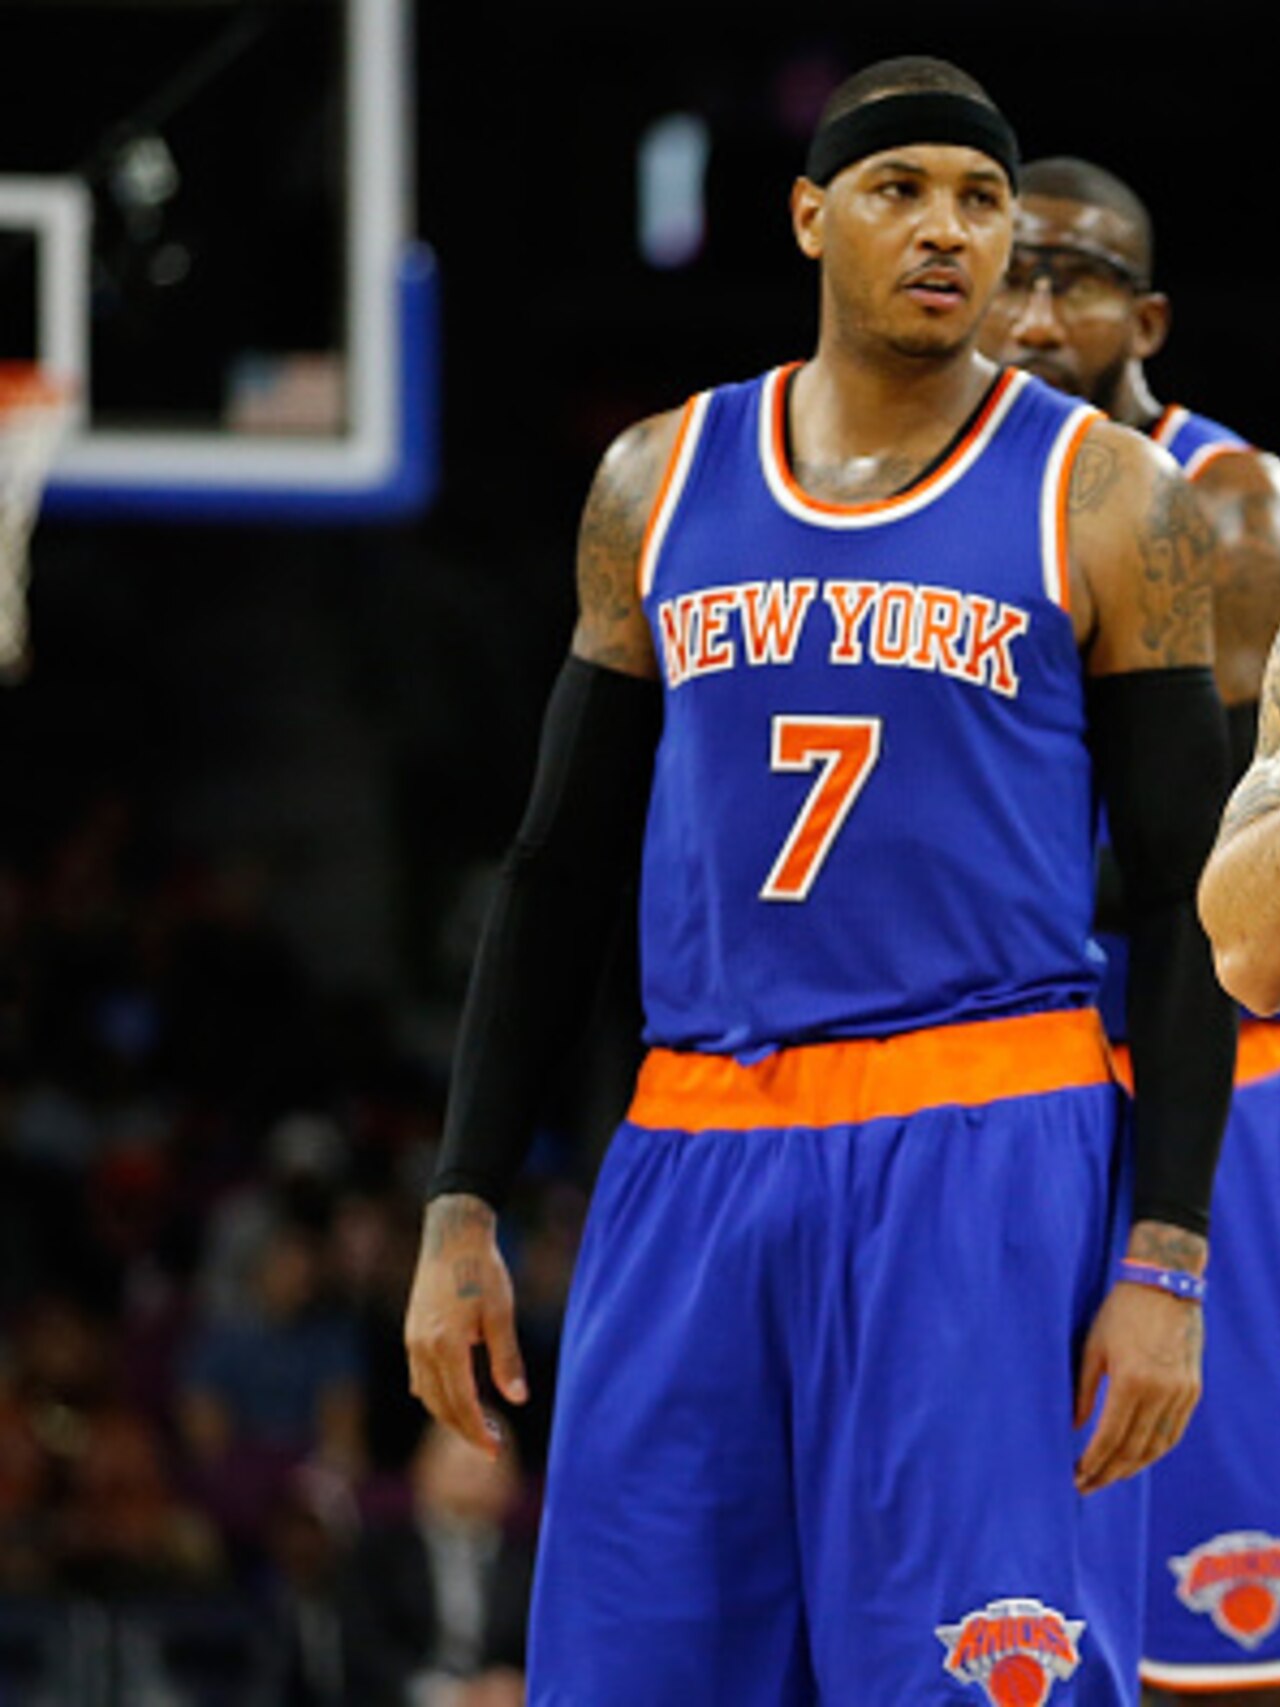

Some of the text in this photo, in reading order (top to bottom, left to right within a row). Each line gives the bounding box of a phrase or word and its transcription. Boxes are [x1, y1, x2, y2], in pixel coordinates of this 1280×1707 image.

[658, 578, 1029, 699] NEW YORK
[759, 715, 882, 902] 7
